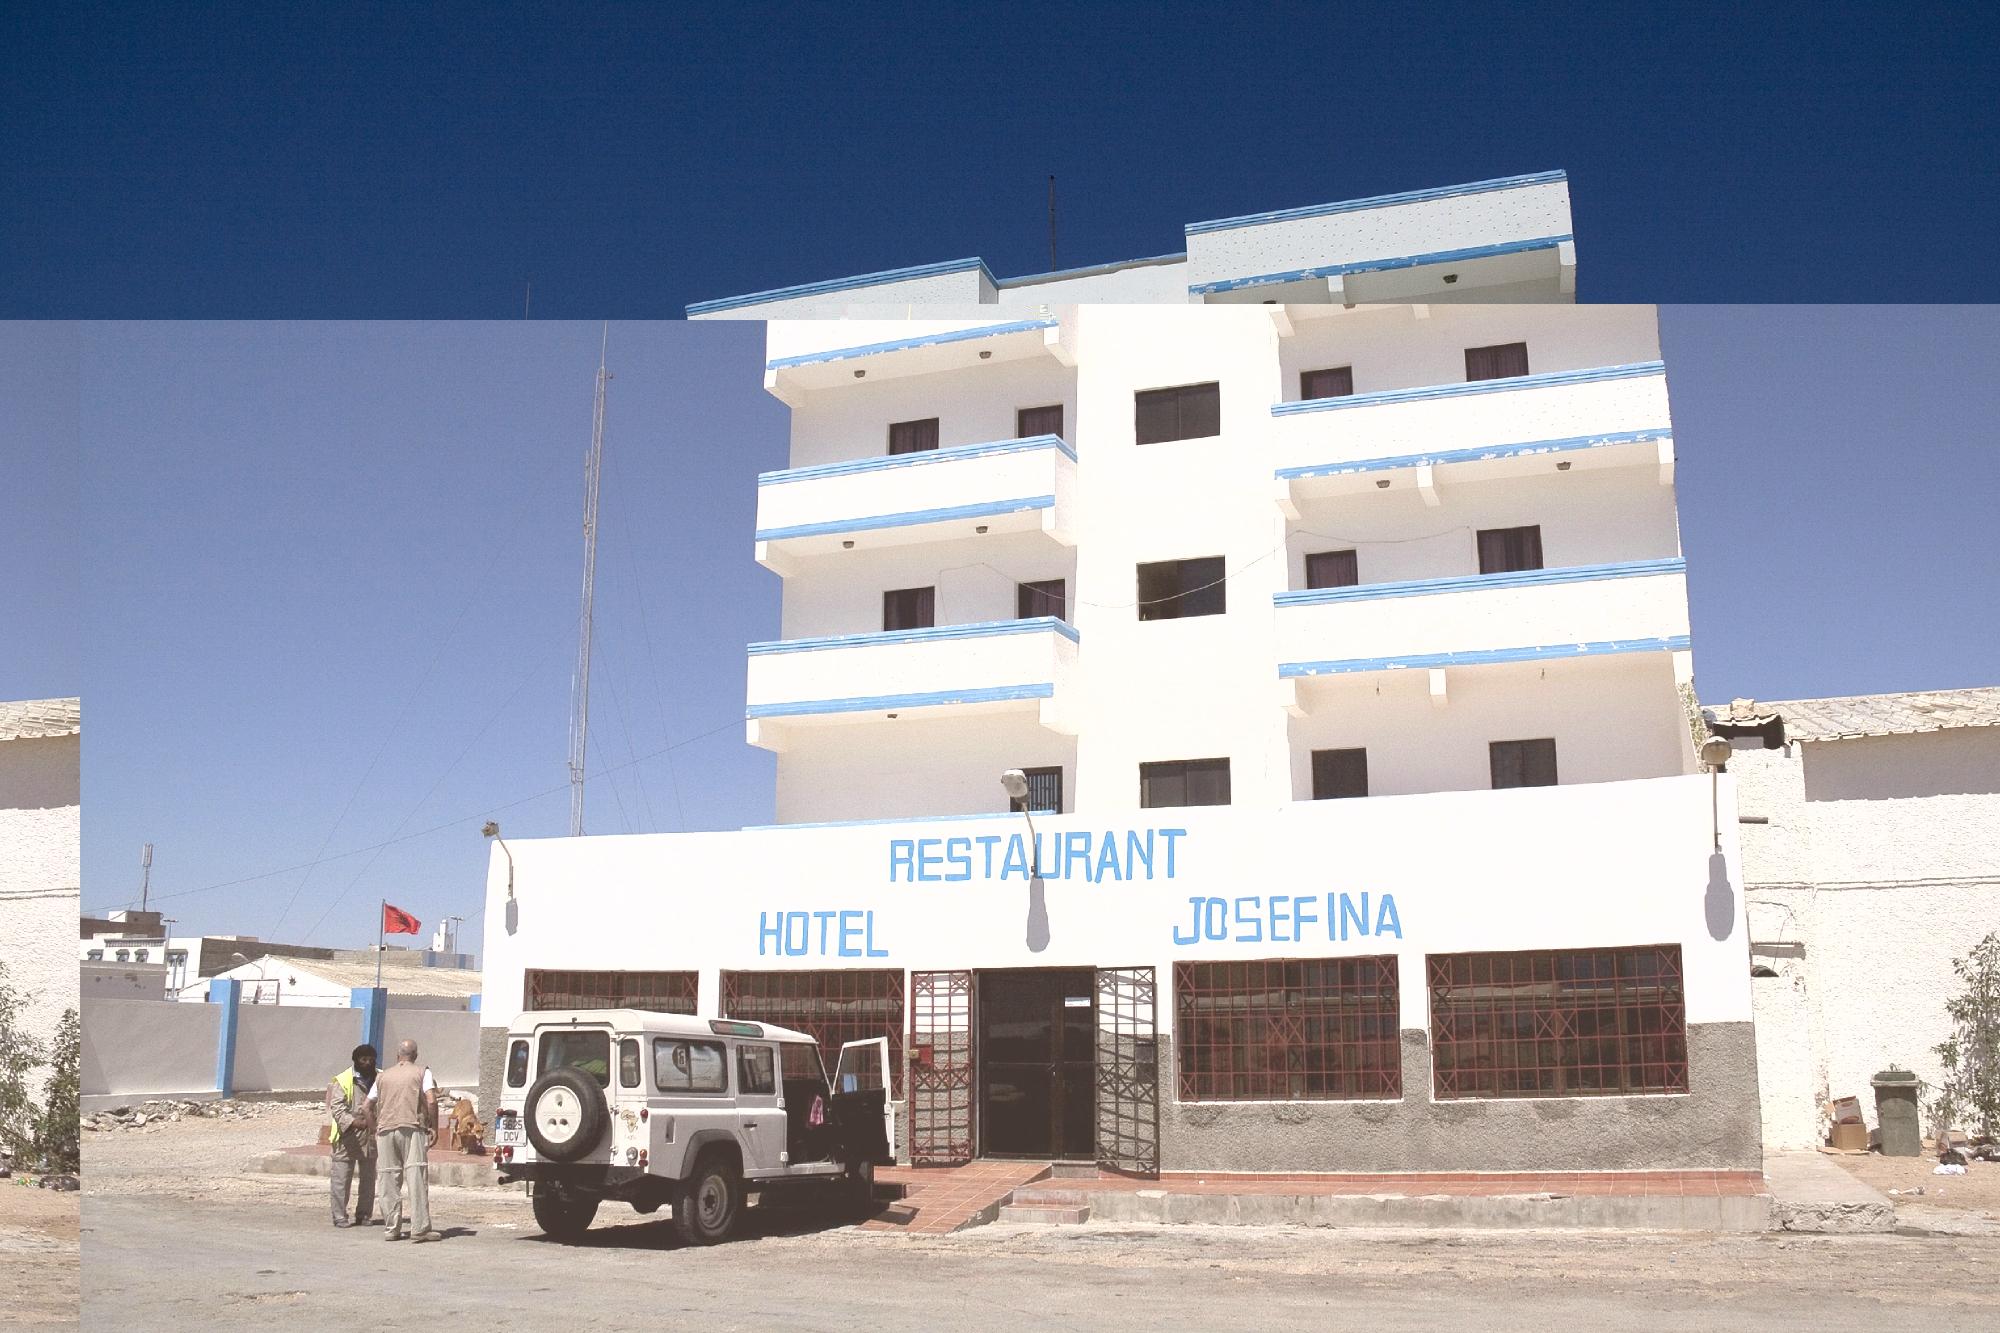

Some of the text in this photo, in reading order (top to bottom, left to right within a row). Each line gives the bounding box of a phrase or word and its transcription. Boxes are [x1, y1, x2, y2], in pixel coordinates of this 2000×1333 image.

[889, 828, 1188, 885] RESTAURANT
[758, 891, 1404, 958] HOTEL JOSEFINA
